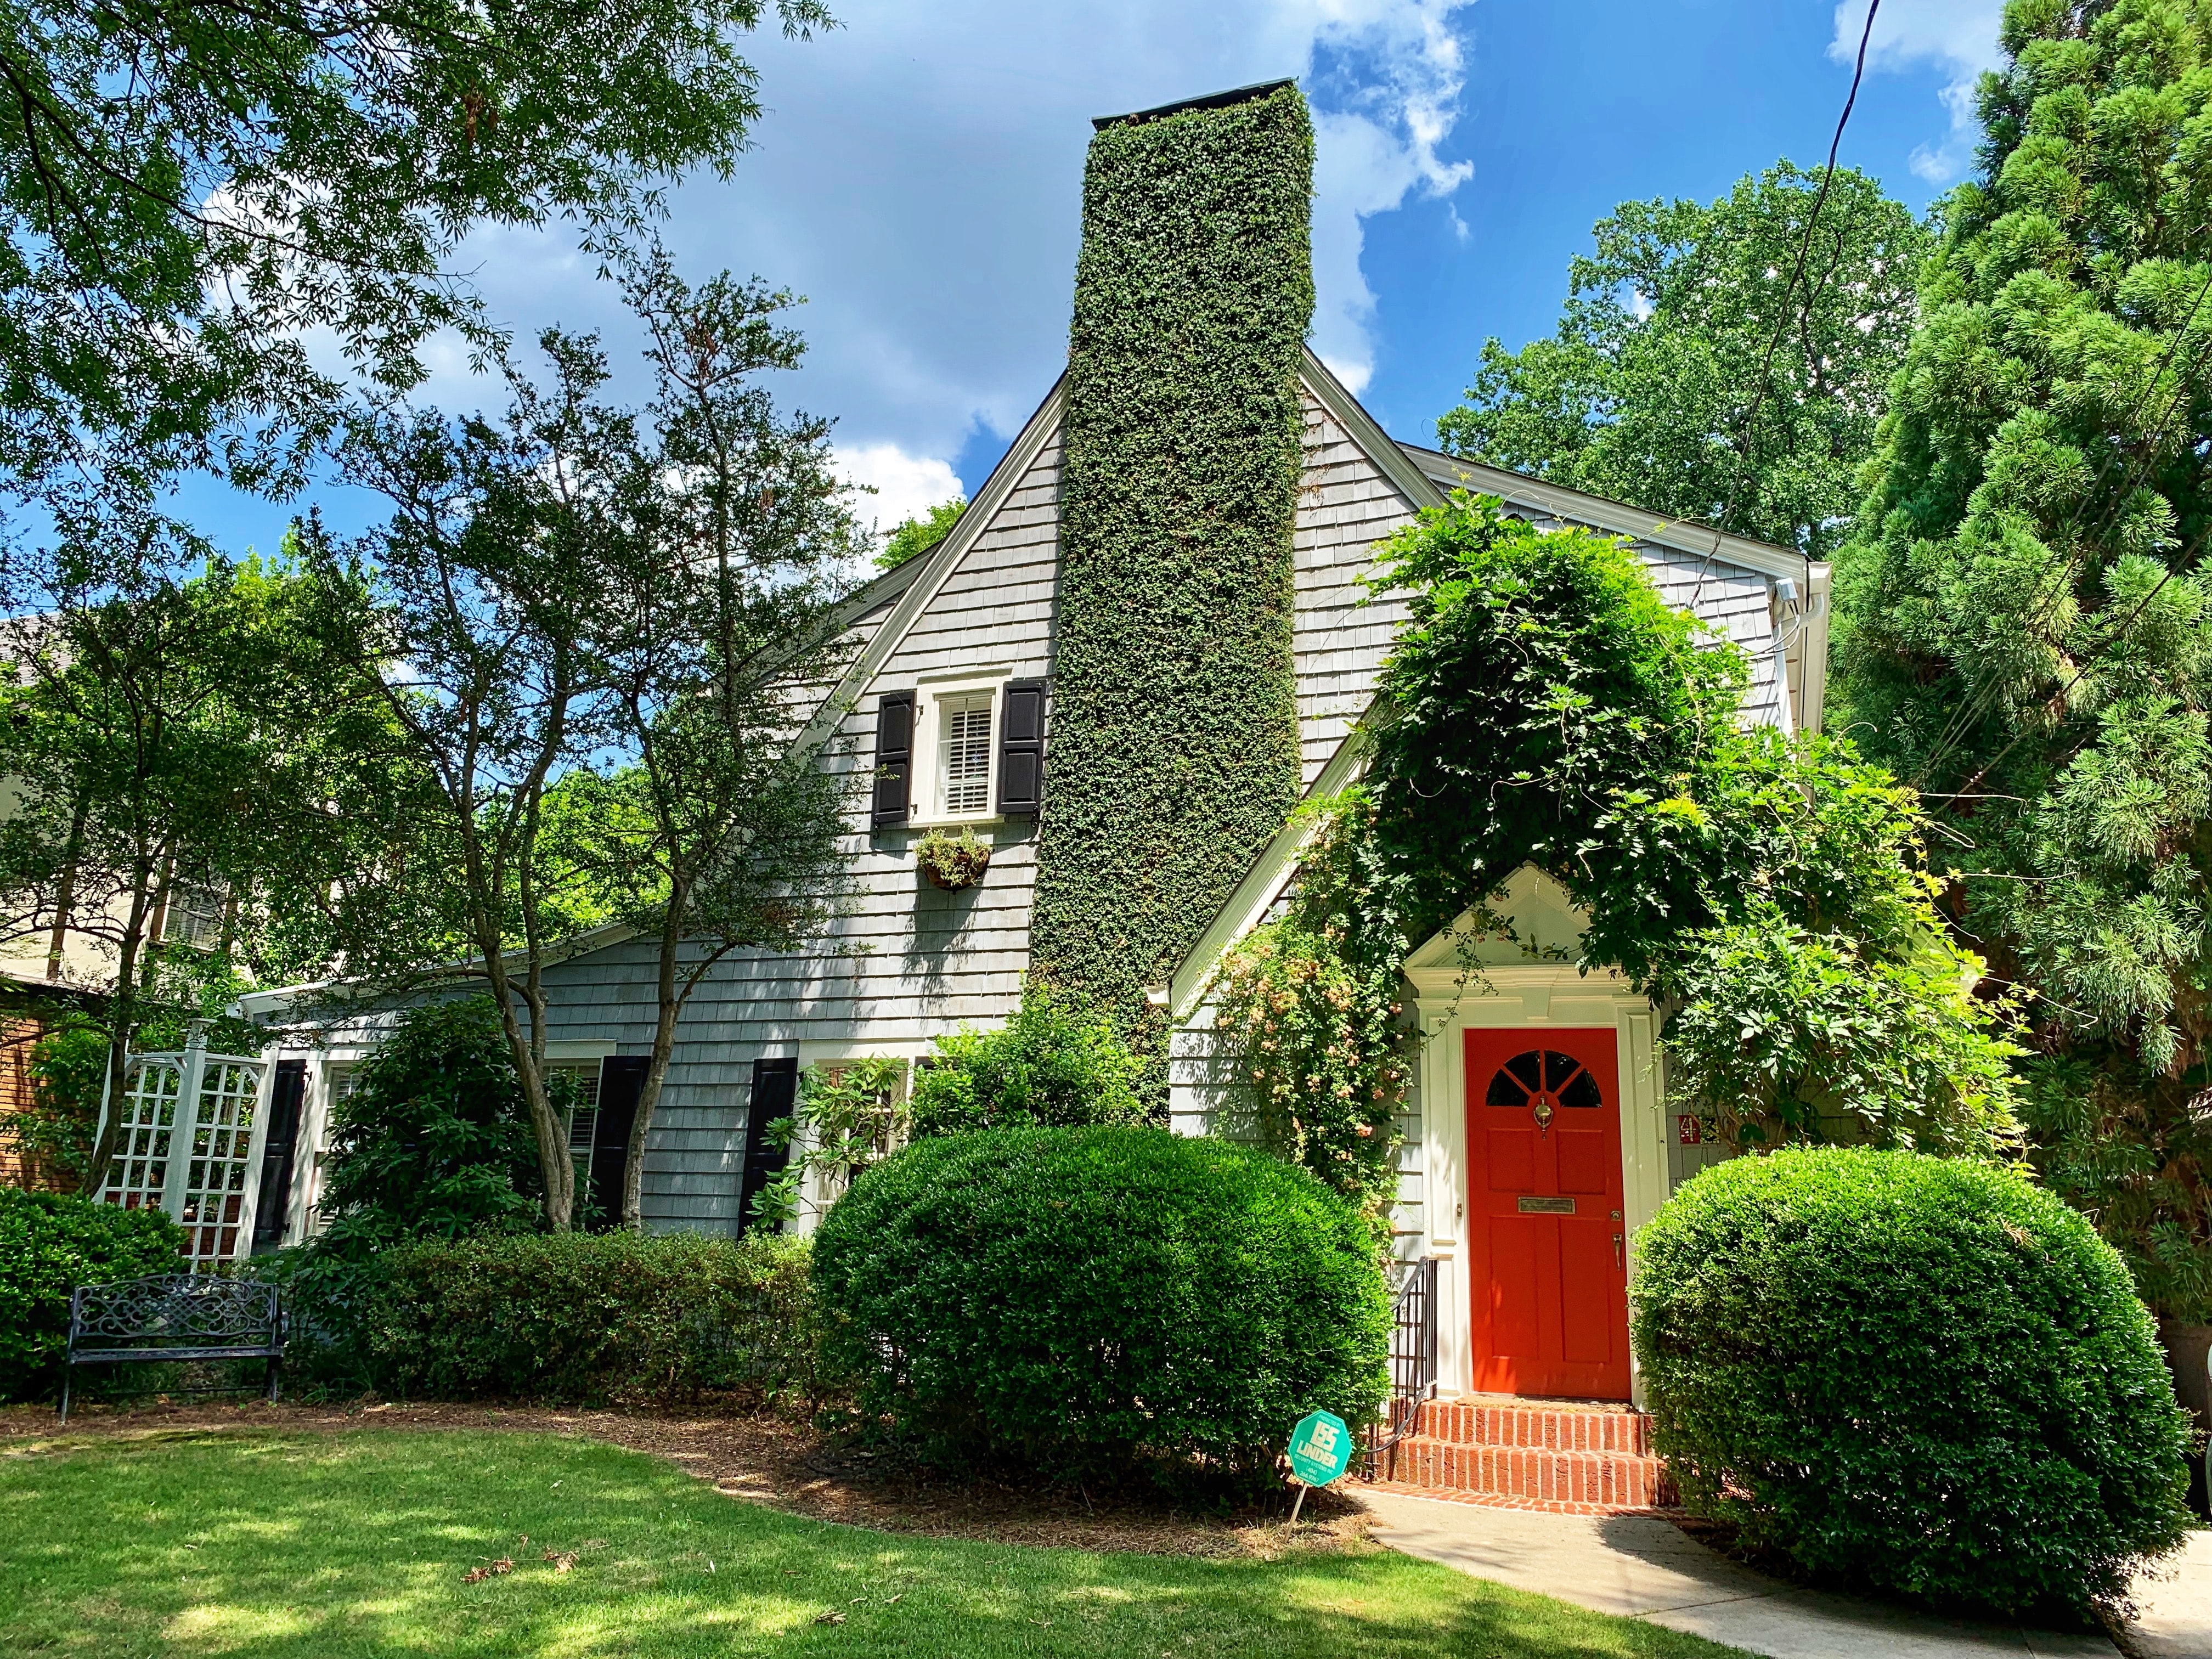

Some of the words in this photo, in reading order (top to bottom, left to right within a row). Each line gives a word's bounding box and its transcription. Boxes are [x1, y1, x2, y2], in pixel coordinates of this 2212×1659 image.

[1294, 1453, 1311, 1464] SECURITY
[1311, 1462, 1327, 1471] SYSTEMS
[1296, 1440, 1338, 1469] LINDER
